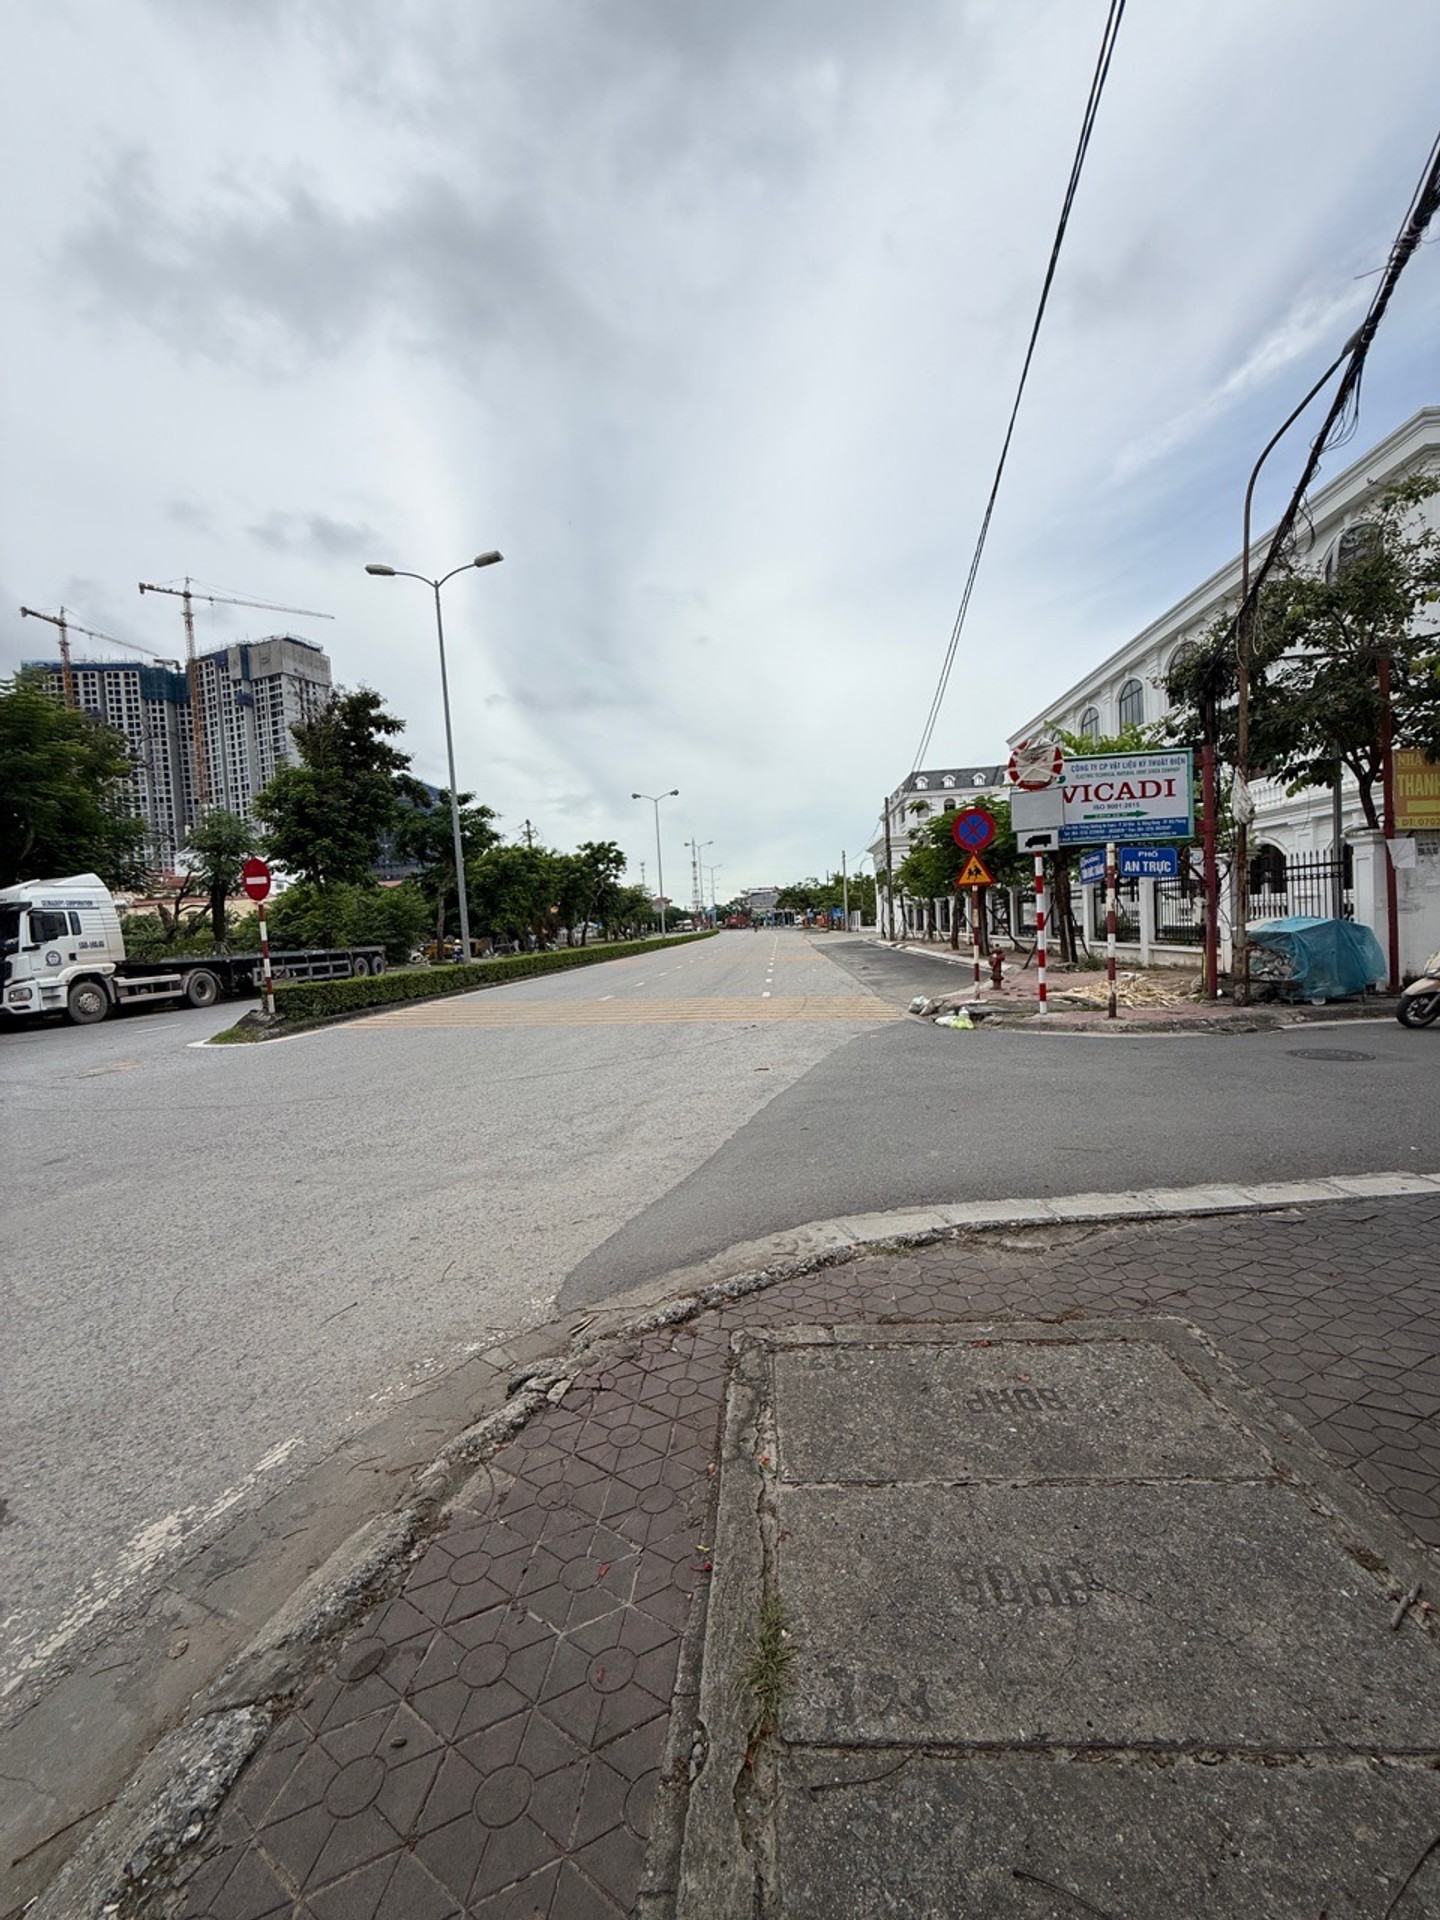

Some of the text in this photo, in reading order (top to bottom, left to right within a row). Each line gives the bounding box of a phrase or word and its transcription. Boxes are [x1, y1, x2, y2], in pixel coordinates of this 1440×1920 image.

[1071, 763, 1089, 773] CÔNG
[1090, 763, 1098, 772] TY
[1099, 763, 1108, 771] CP
[1110, 760, 1121, 770] VẬT
[1122, 760, 1137, 769] LIỆU
[1063, 778, 1176, 804] VICADI
[1093, 803, 1105, 811] ISO
[1138, 848, 1159, 858] PHỐ
[1124, 859, 1172, 874] AN TRỰC
